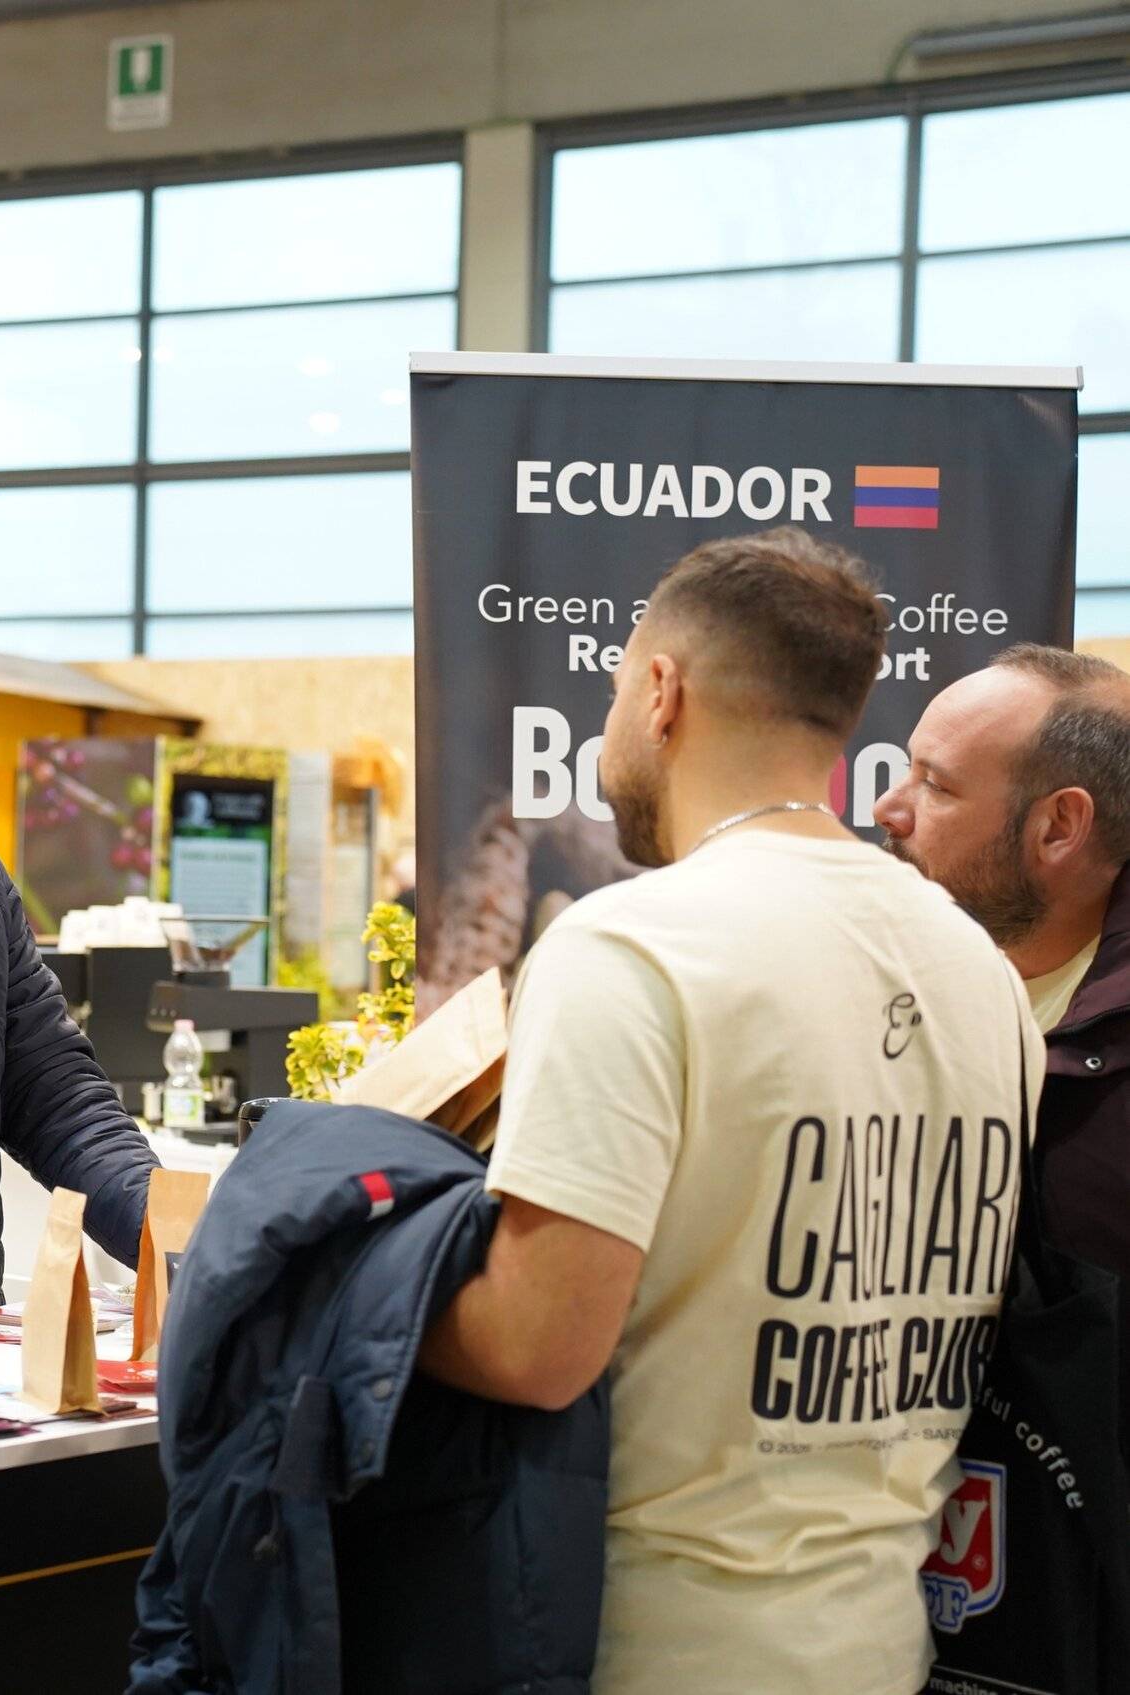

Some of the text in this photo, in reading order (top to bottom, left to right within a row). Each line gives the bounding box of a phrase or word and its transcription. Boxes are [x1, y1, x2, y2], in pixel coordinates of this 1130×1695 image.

[516, 460, 833, 523] ECUADOR
[477, 583, 615, 625] Green
[1014, 1421, 1084, 1510] coffee
